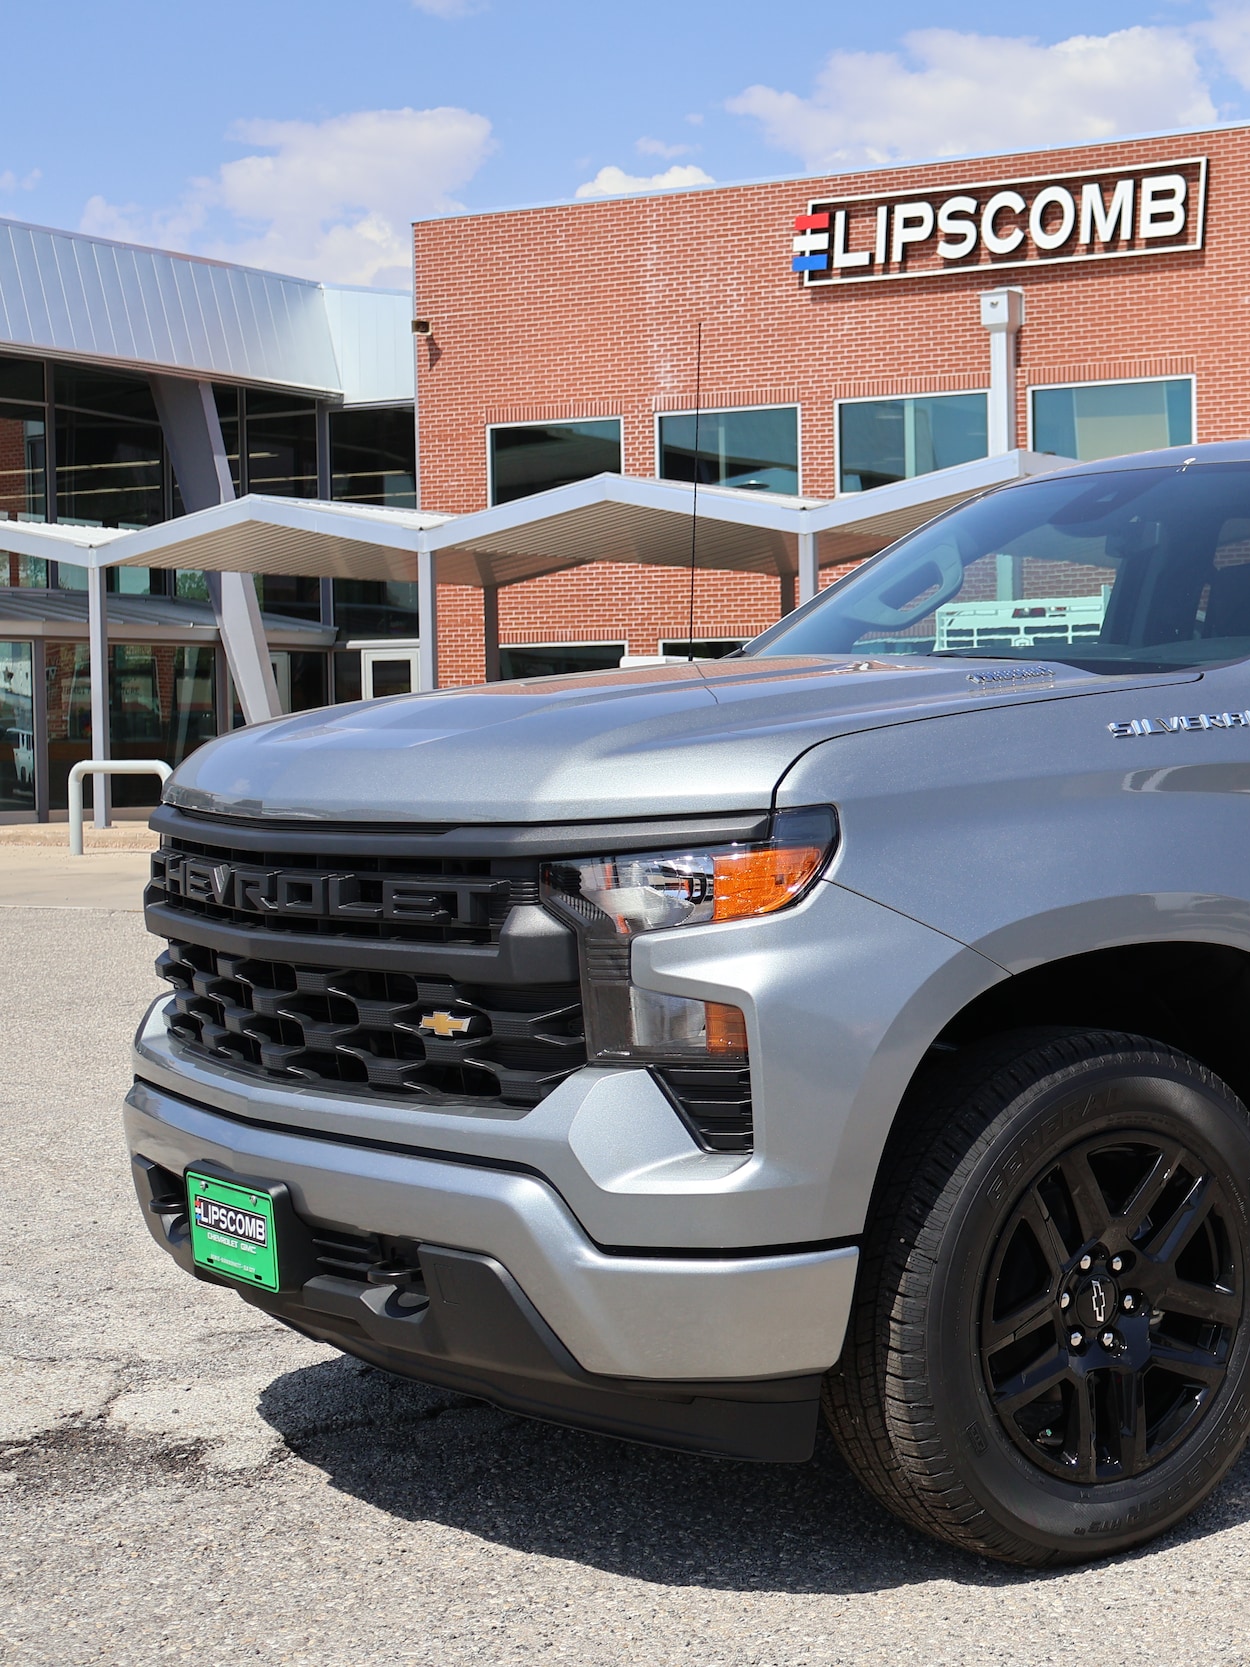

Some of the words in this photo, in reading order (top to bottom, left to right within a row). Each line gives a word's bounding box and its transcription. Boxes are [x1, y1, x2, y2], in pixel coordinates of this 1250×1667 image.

[833, 173, 1187, 269] LIPSCOMB
[150, 849, 512, 927] CHEVROLET
[200, 1201, 266, 1242] LIPSCOMB
